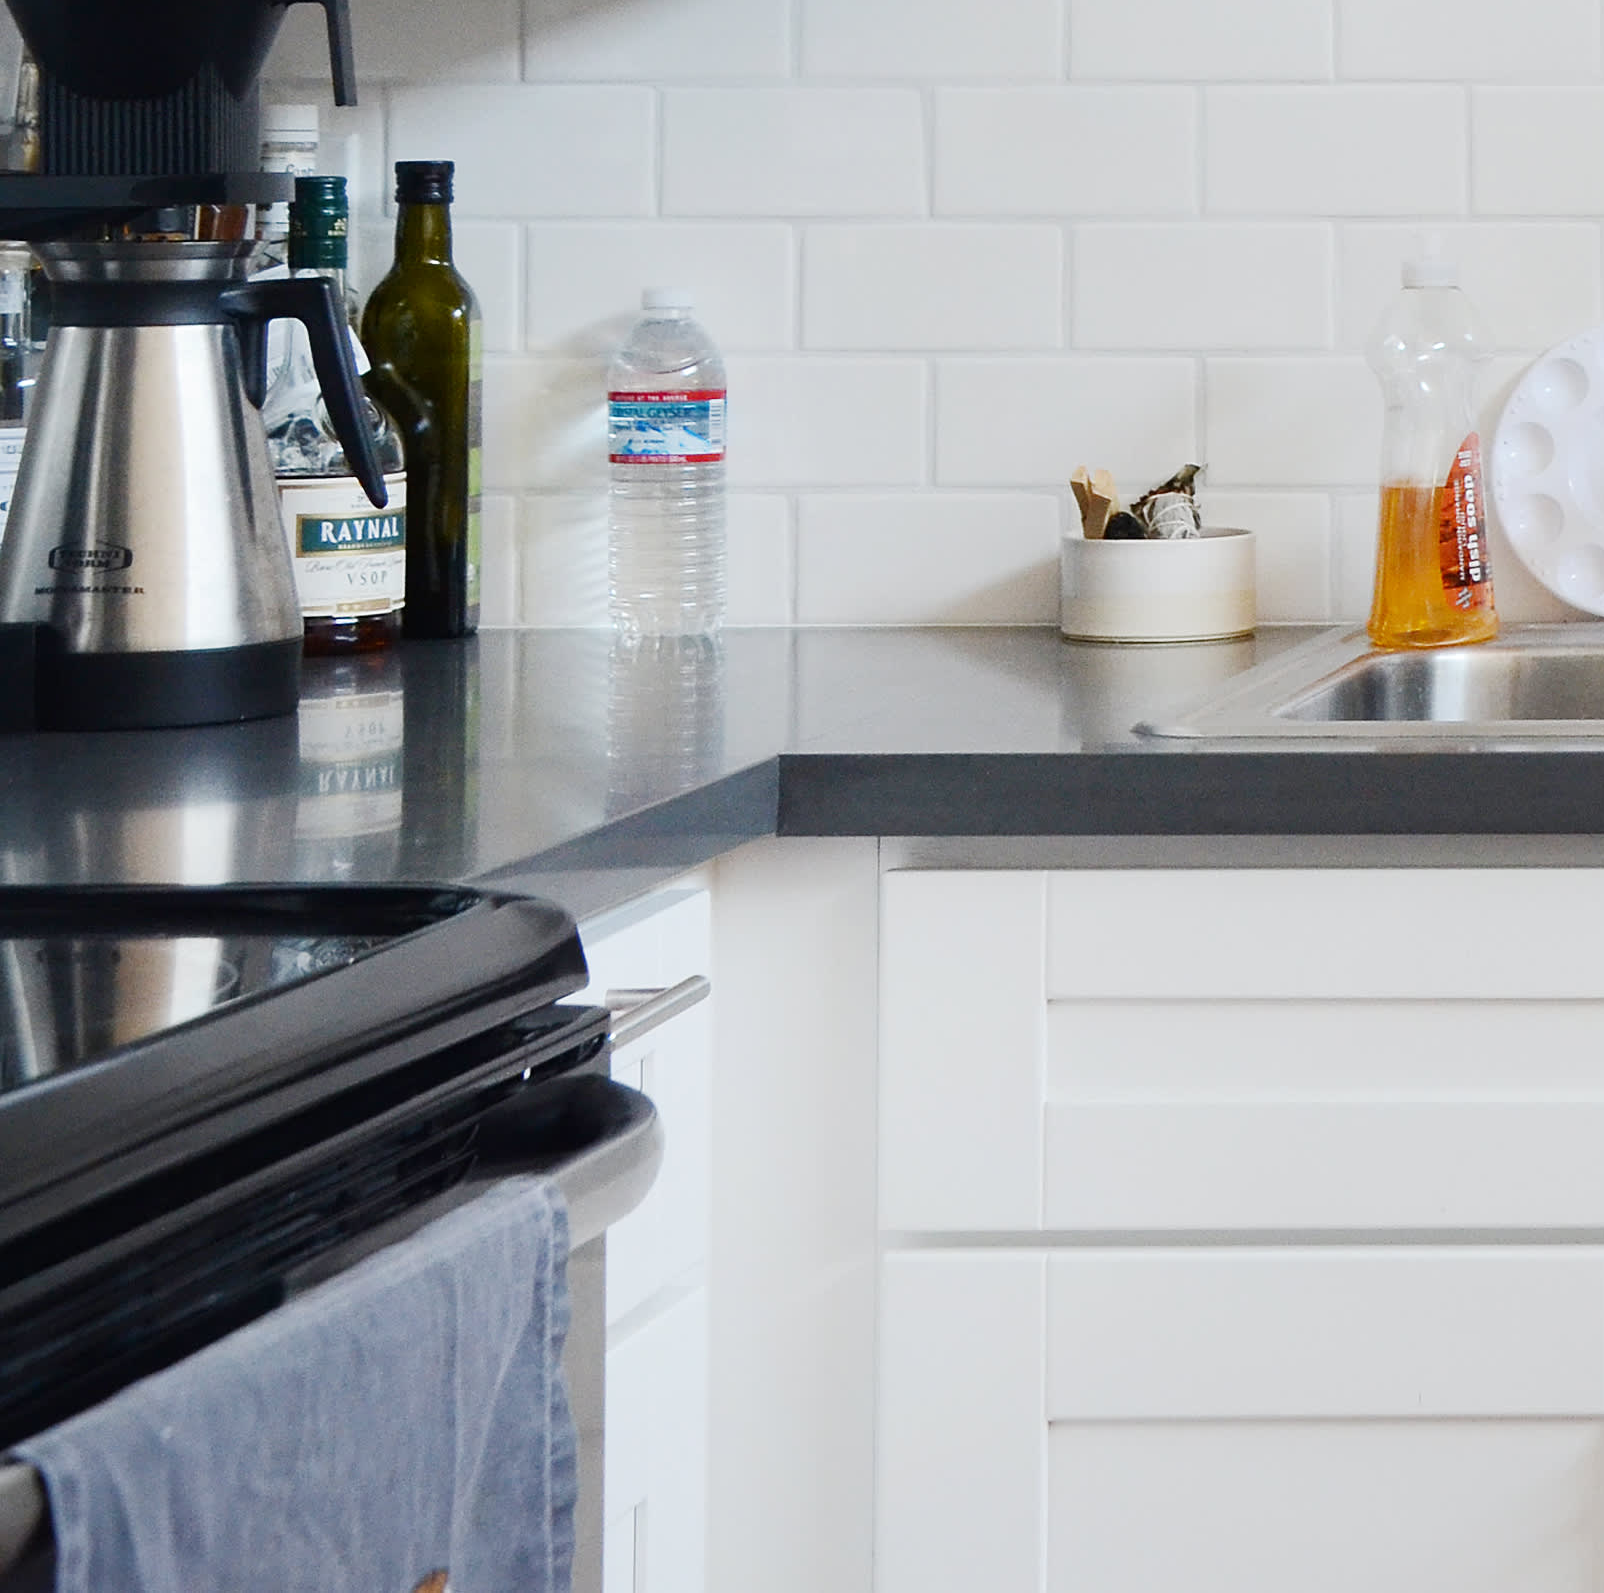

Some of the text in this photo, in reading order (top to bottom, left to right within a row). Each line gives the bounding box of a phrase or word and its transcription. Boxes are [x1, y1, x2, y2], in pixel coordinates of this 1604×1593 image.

[1464, 475, 1476, 528] soap
[321, 516, 399, 543] RAYNAL
[1467, 534, 1481, 582] dish
[346, 570, 387, 585] VSOP
